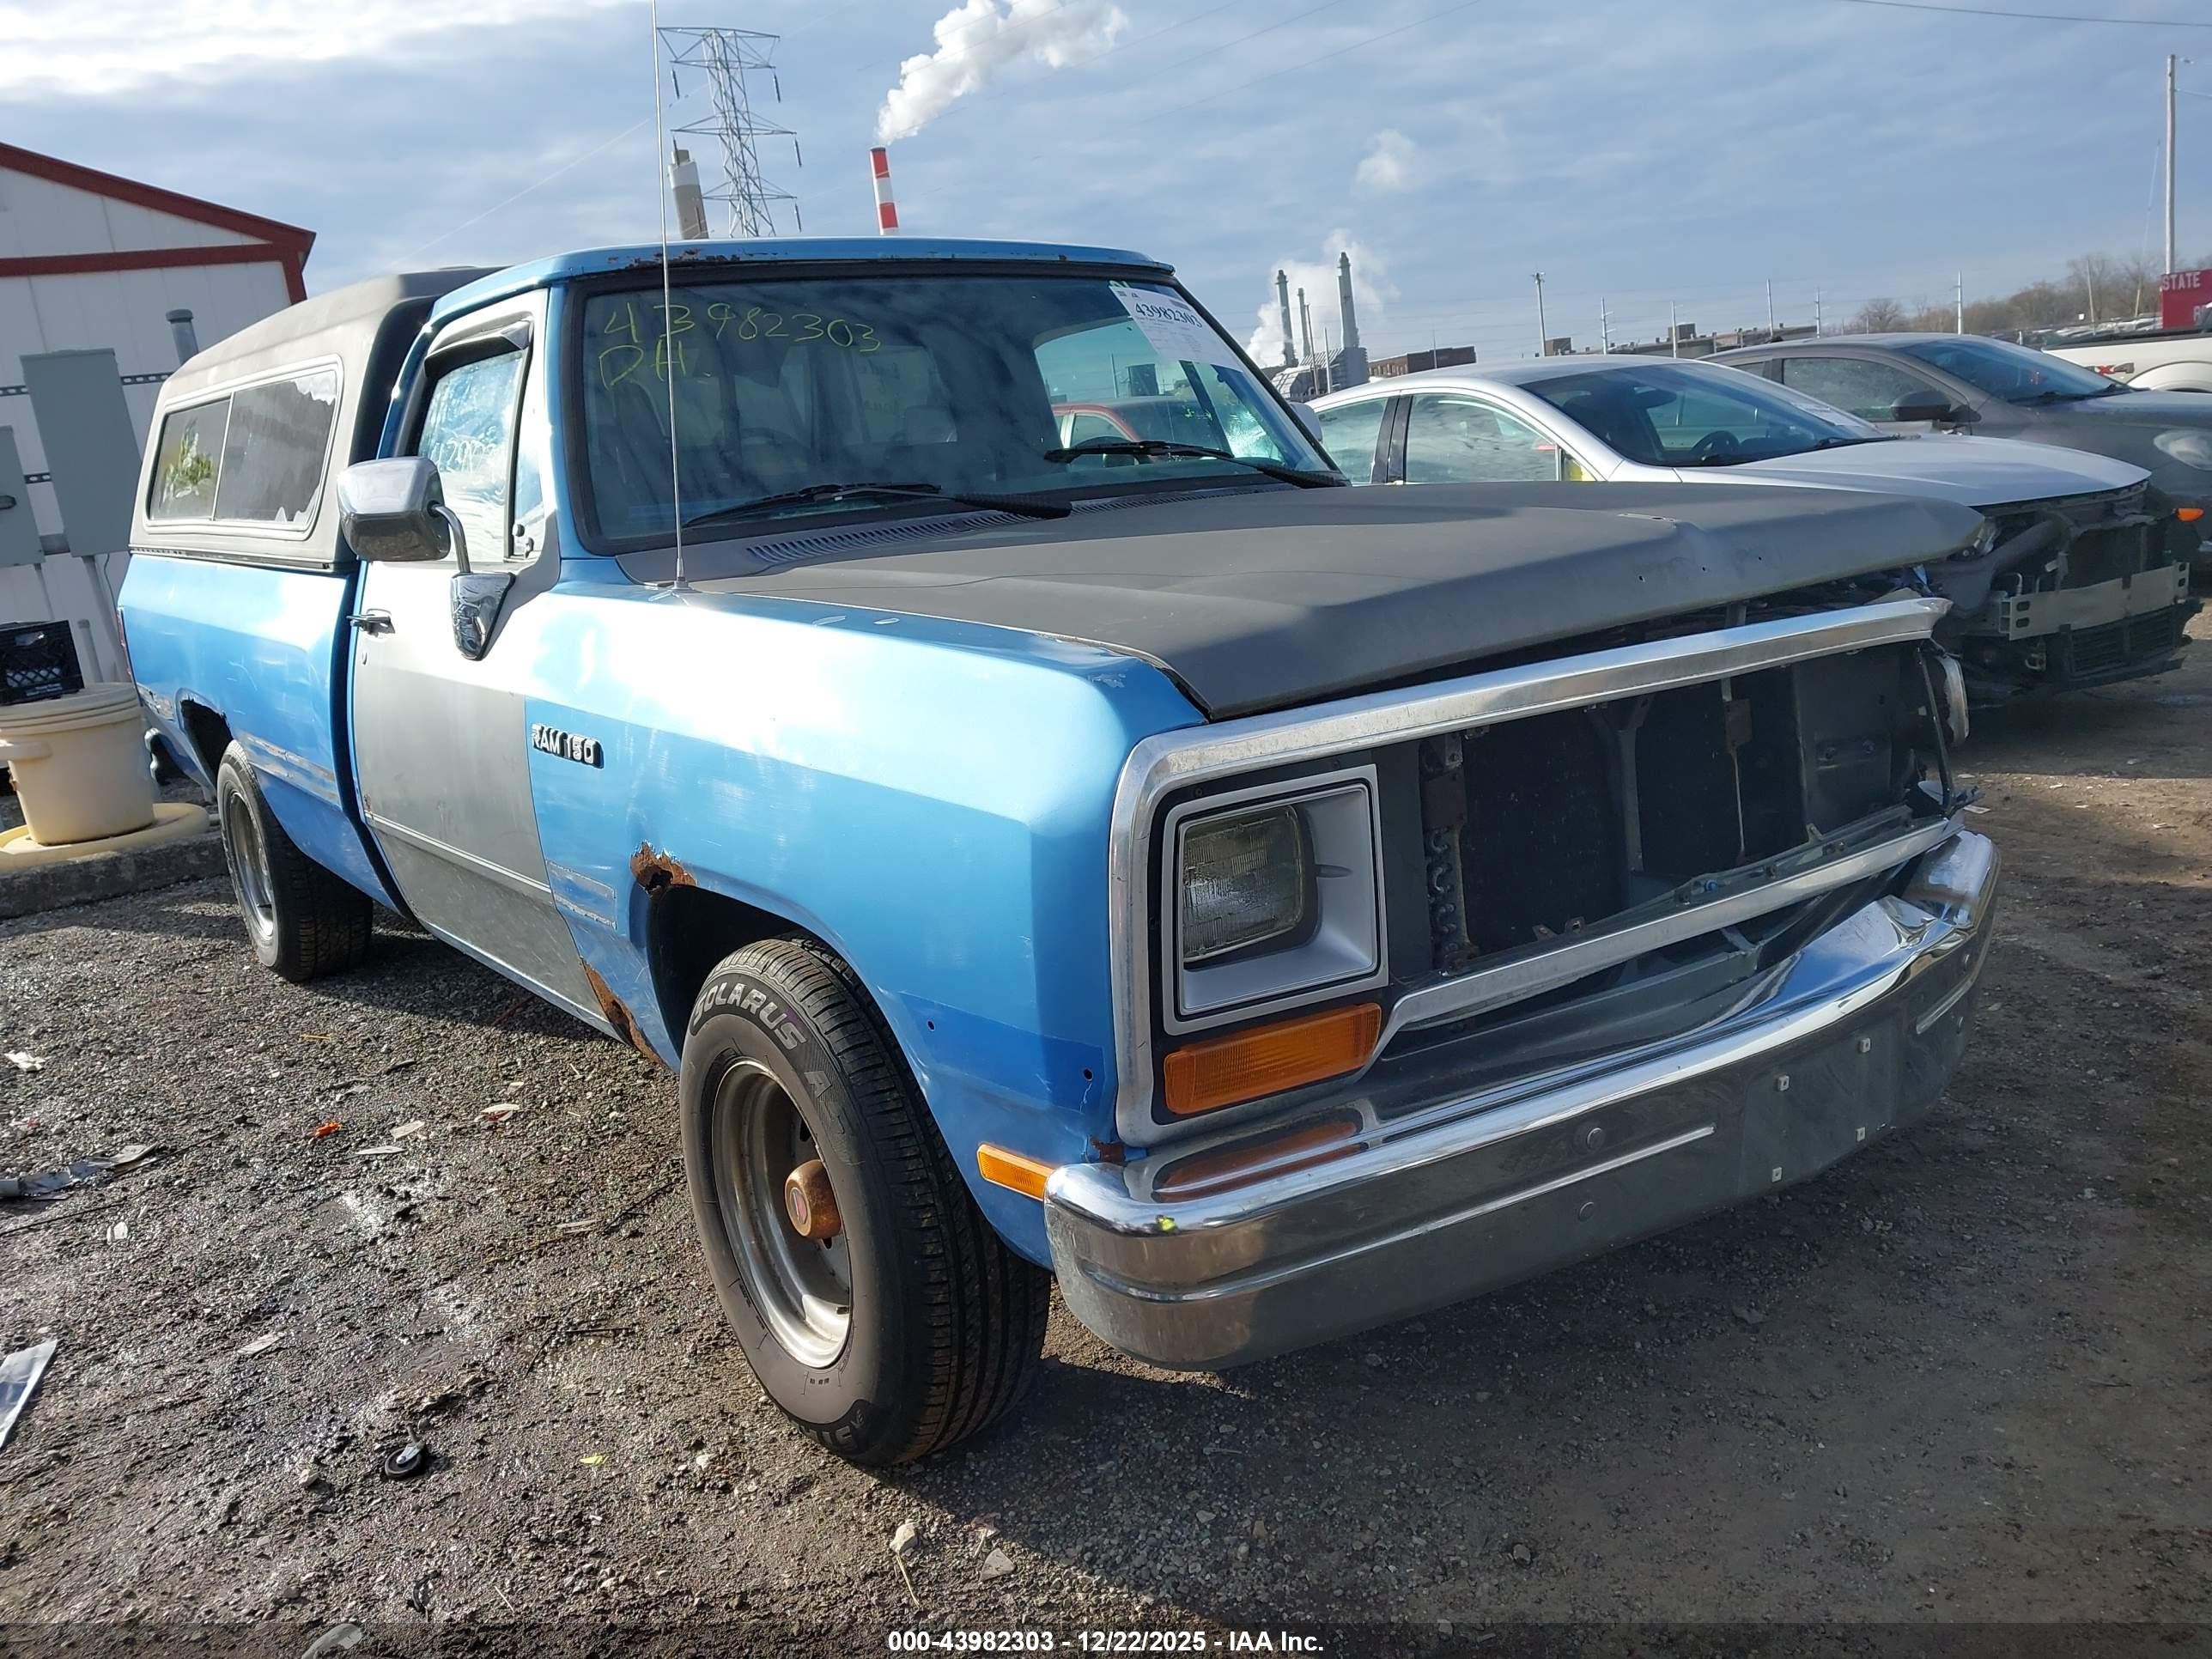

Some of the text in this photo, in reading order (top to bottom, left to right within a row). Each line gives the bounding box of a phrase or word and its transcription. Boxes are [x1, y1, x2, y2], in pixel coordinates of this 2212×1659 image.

[2163, 271, 2201, 290] STATE
[603, 301, 881, 353] 43982303
[1134, 302, 1203, 328] 43982303
[531, 723, 594, 764] RAM 150
[693, 981, 807, 1050] SOLARUS
